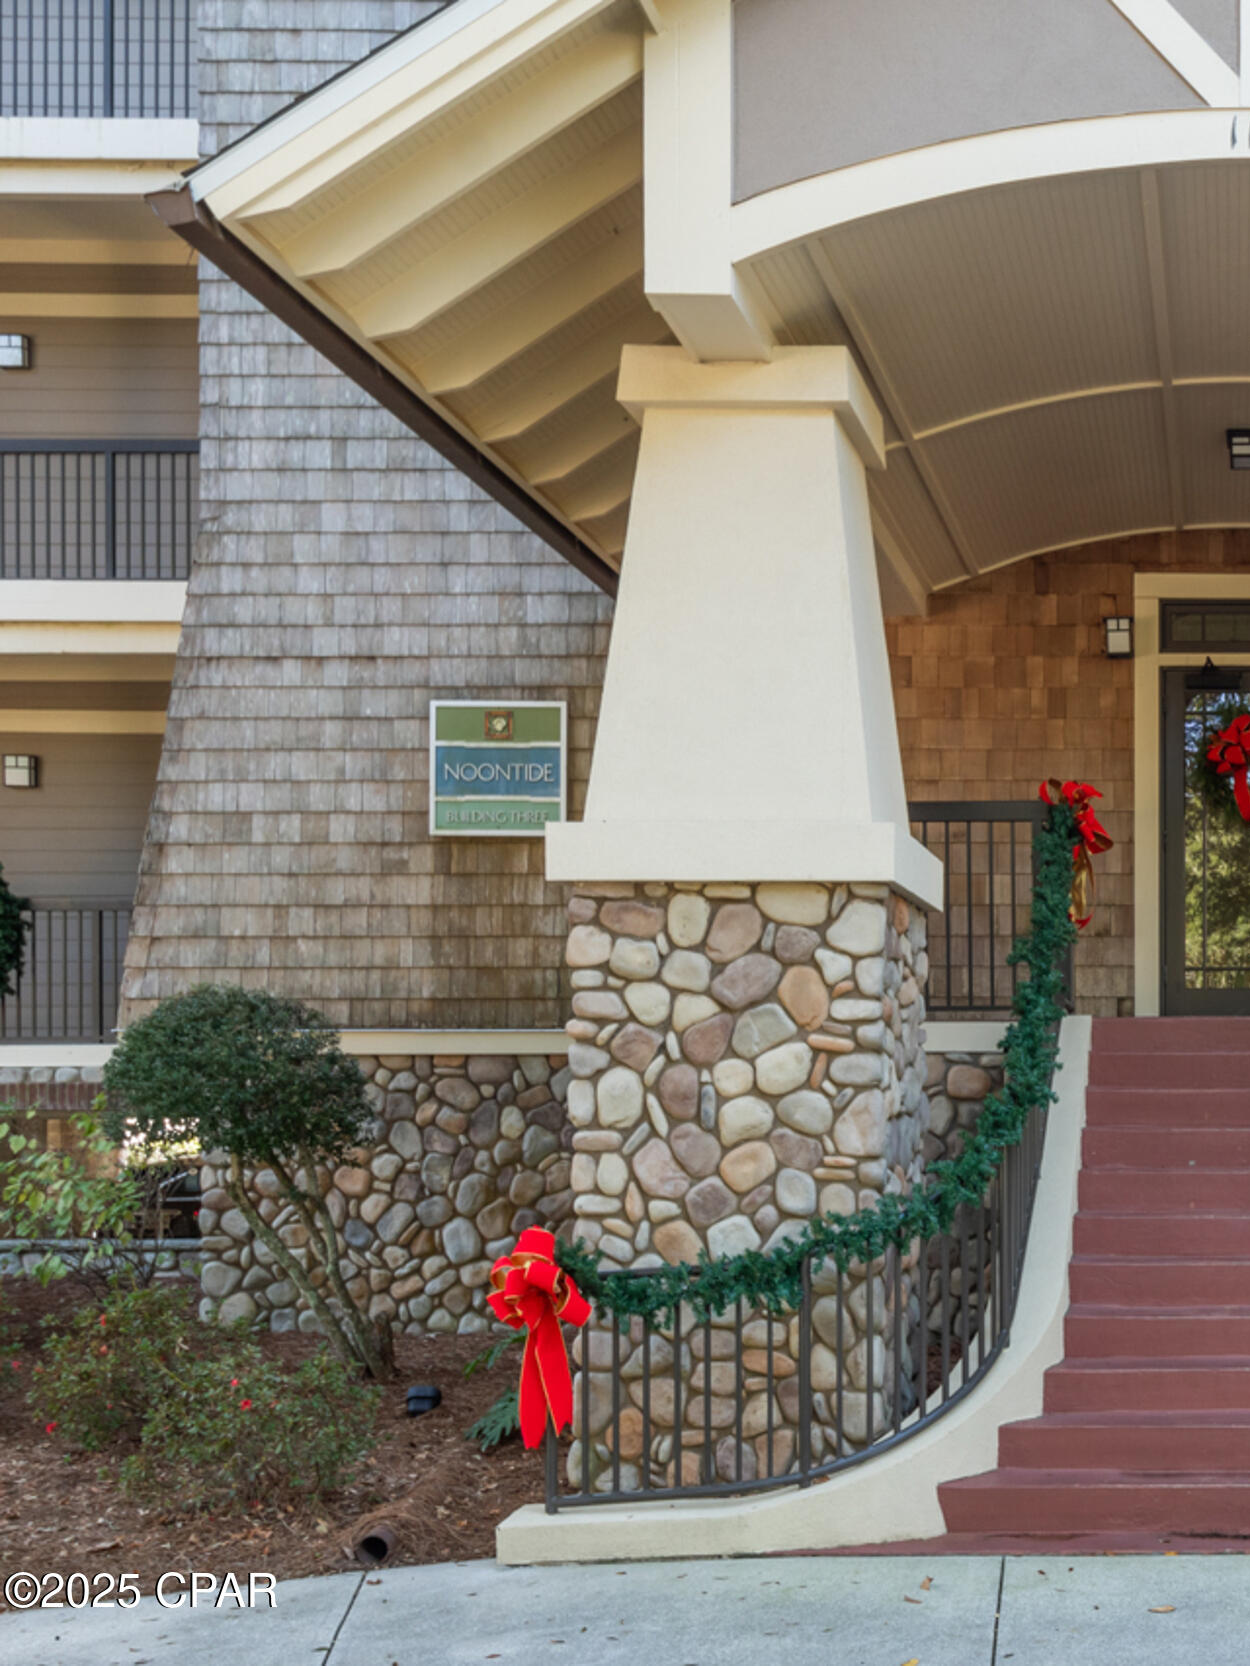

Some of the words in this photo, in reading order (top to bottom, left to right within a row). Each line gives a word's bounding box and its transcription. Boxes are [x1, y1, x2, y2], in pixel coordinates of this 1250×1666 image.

[444, 763, 555, 782] NOONTIDE
[446, 810, 507, 824] BUILDING
[510, 809, 550, 824] THREE
